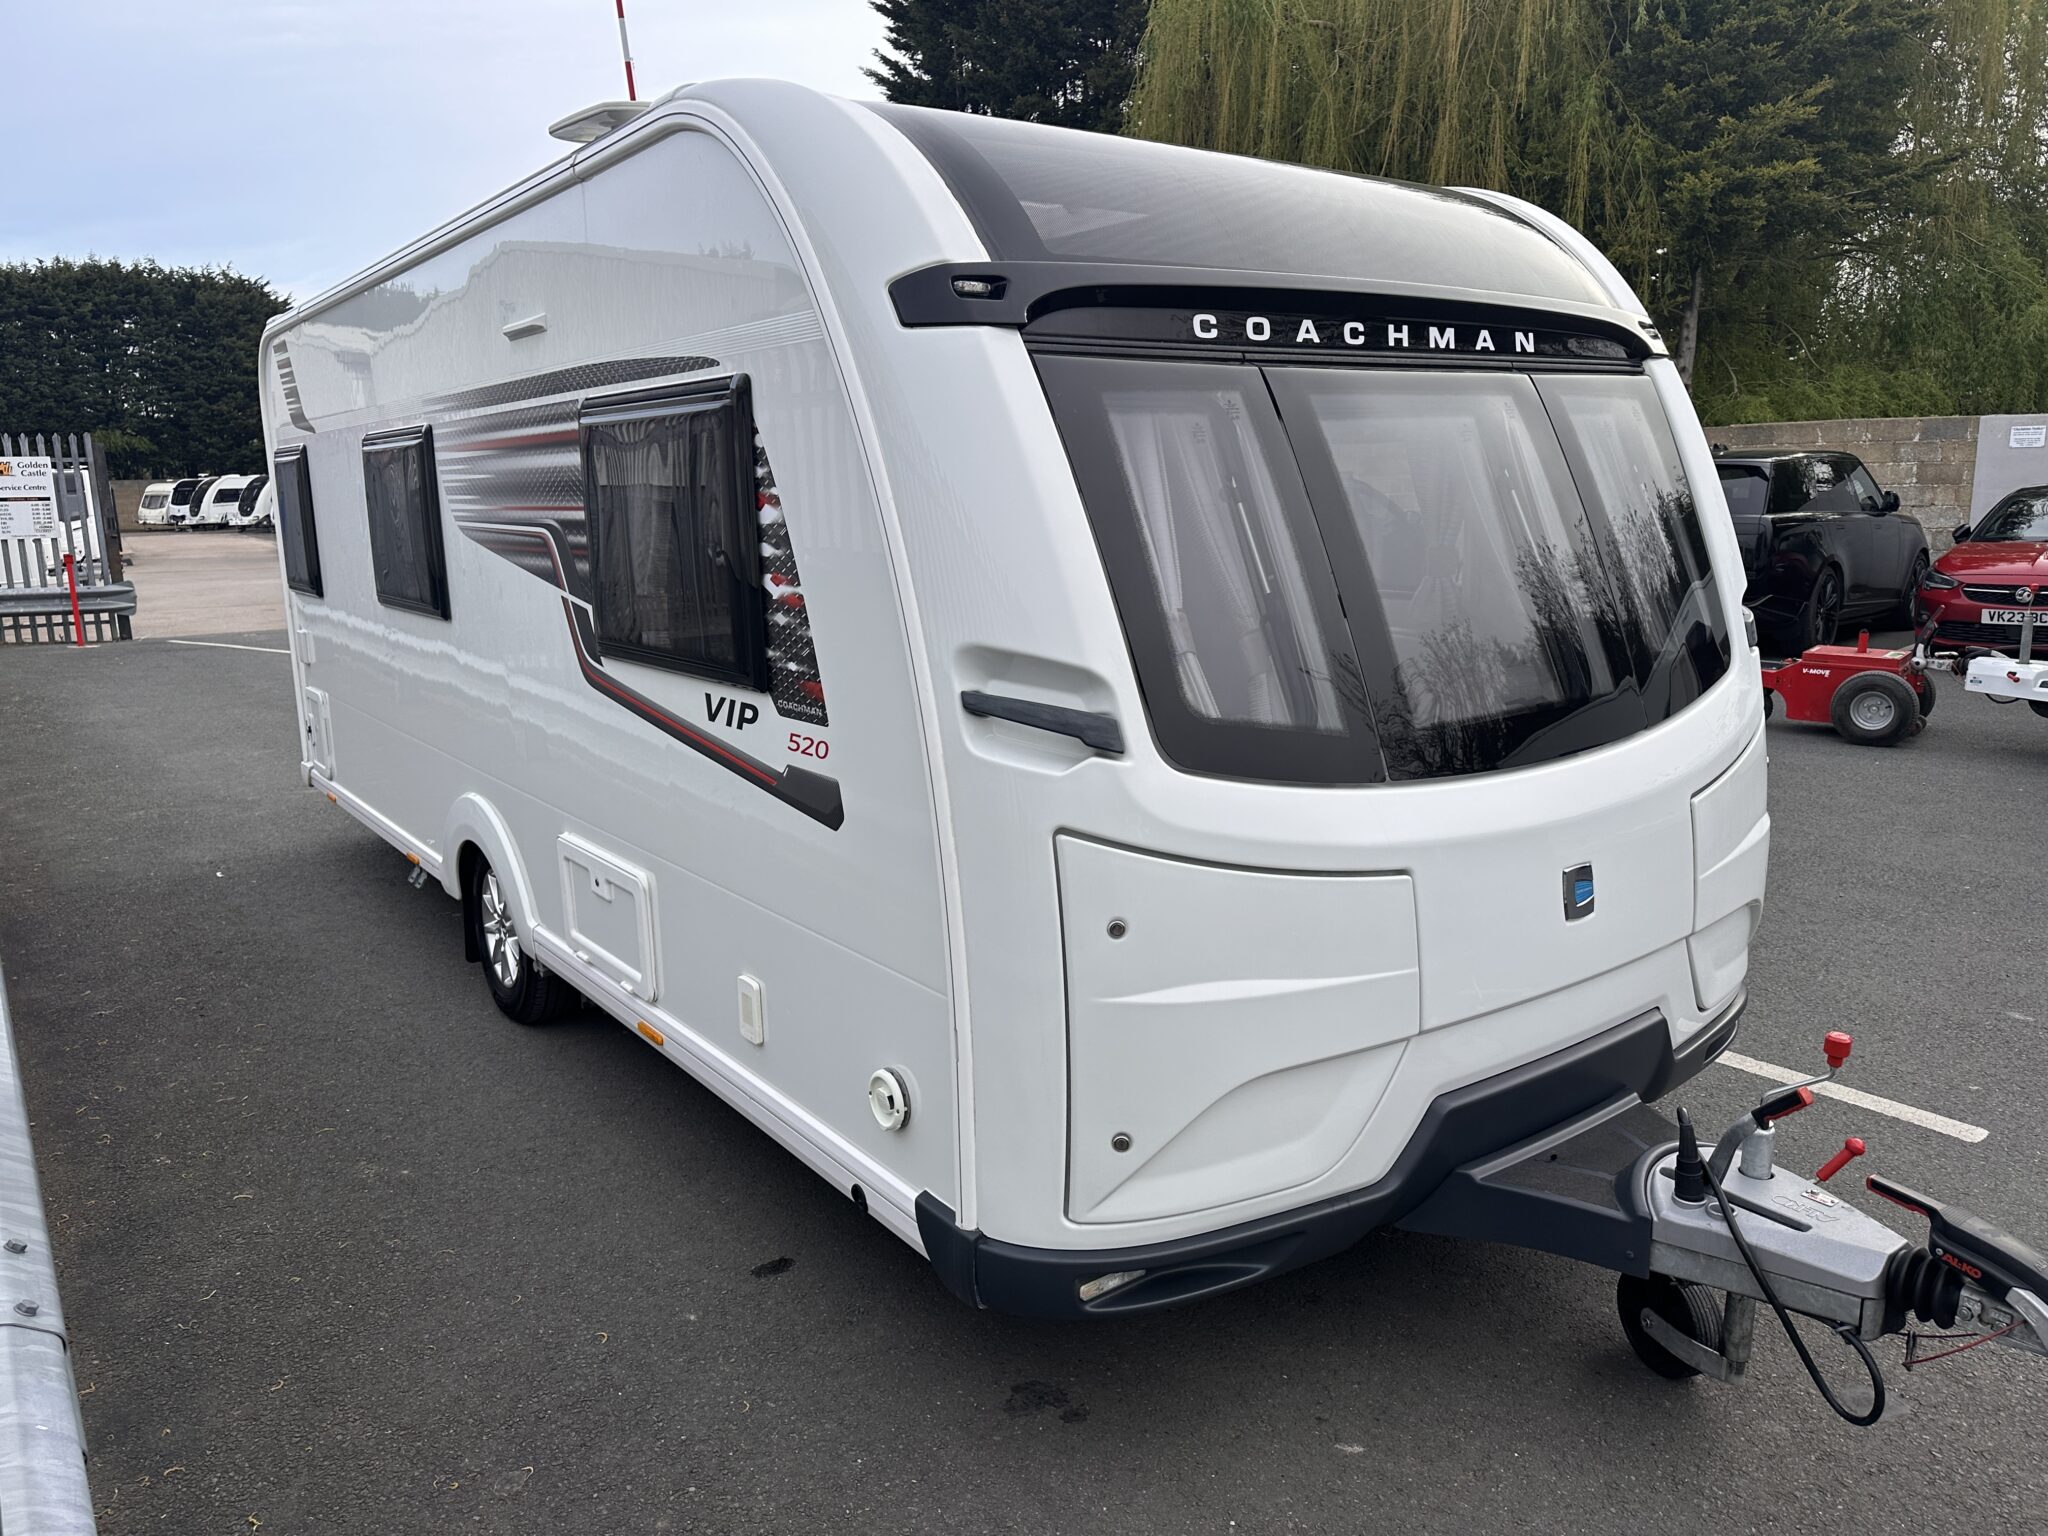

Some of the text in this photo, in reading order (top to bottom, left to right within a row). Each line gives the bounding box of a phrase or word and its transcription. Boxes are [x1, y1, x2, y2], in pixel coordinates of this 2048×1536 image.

[1192, 313, 1536, 353] COACHMAN
[17, 461, 49, 469] Golden
[20, 469, 47, 477] Castle
[1988, 610, 2025, 623] VK23
[1803, 668, 1830, 677] V-MOVE
[704, 692, 759, 731] VIP
[777, 699, 824, 717] COACHMAN
[787, 732, 830, 760] 520
